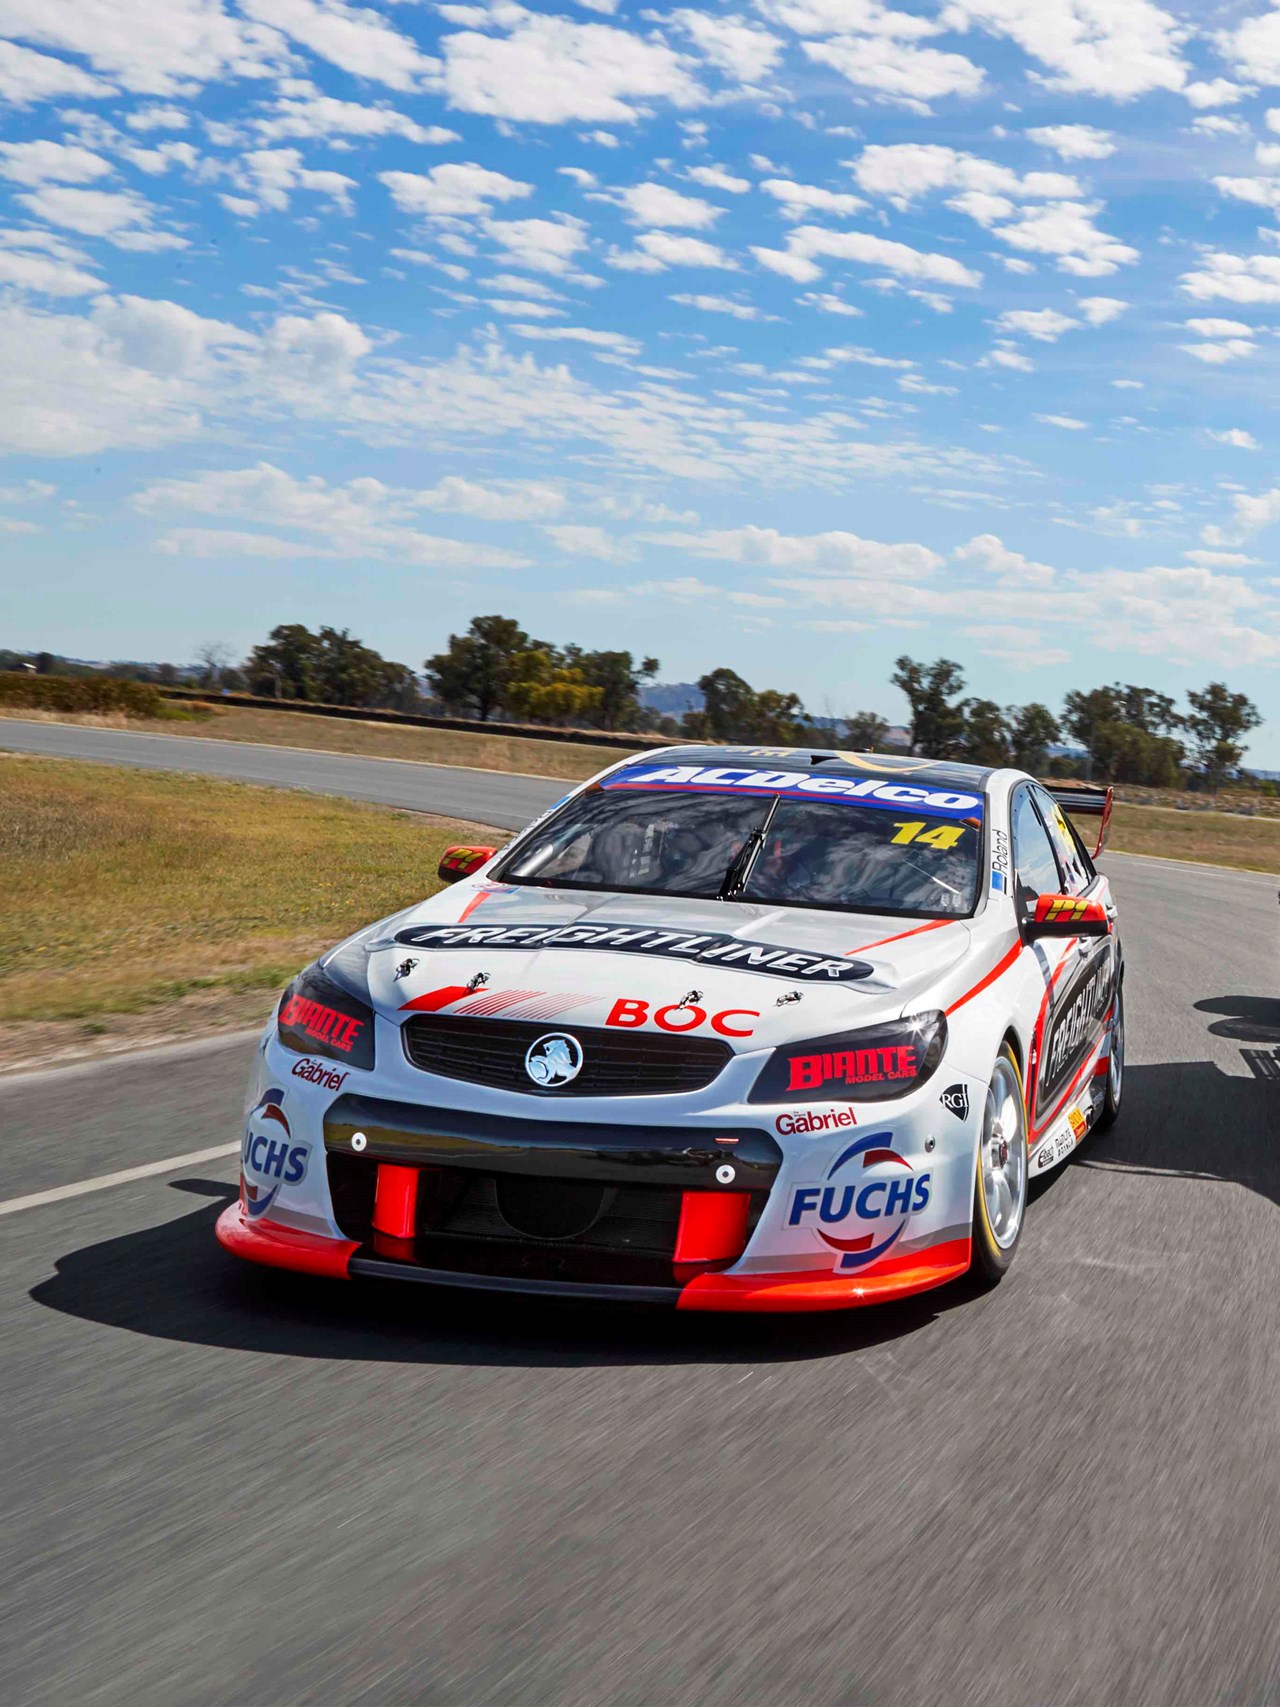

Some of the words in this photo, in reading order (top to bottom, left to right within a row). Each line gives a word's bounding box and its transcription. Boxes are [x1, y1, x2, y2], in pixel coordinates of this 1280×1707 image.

[628, 766, 979, 809] ACDelco
[890, 822, 966, 850] 14
[992, 829, 1008, 875] Roland
[1044, 900, 1089, 920] P1
[411, 924, 855, 979] FREIGHTLINER
[278, 993, 365, 1045] BIANTE
[605, 999, 761, 1038] BOC
[291, 1058, 350, 1091] Gabriel
[786, 1046, 916, 1091] BIANTE
[846, 1073, 885, 1084] MODEL
[887, 1069, 918, 1079] CARS
[942, 1093, 969, 1108] RGI
[776, 1107, 858, 1136] Gabriel
[245, 1130, 308, 1182] UCHS
[789, 1174, 931, 1226] FUCHS
